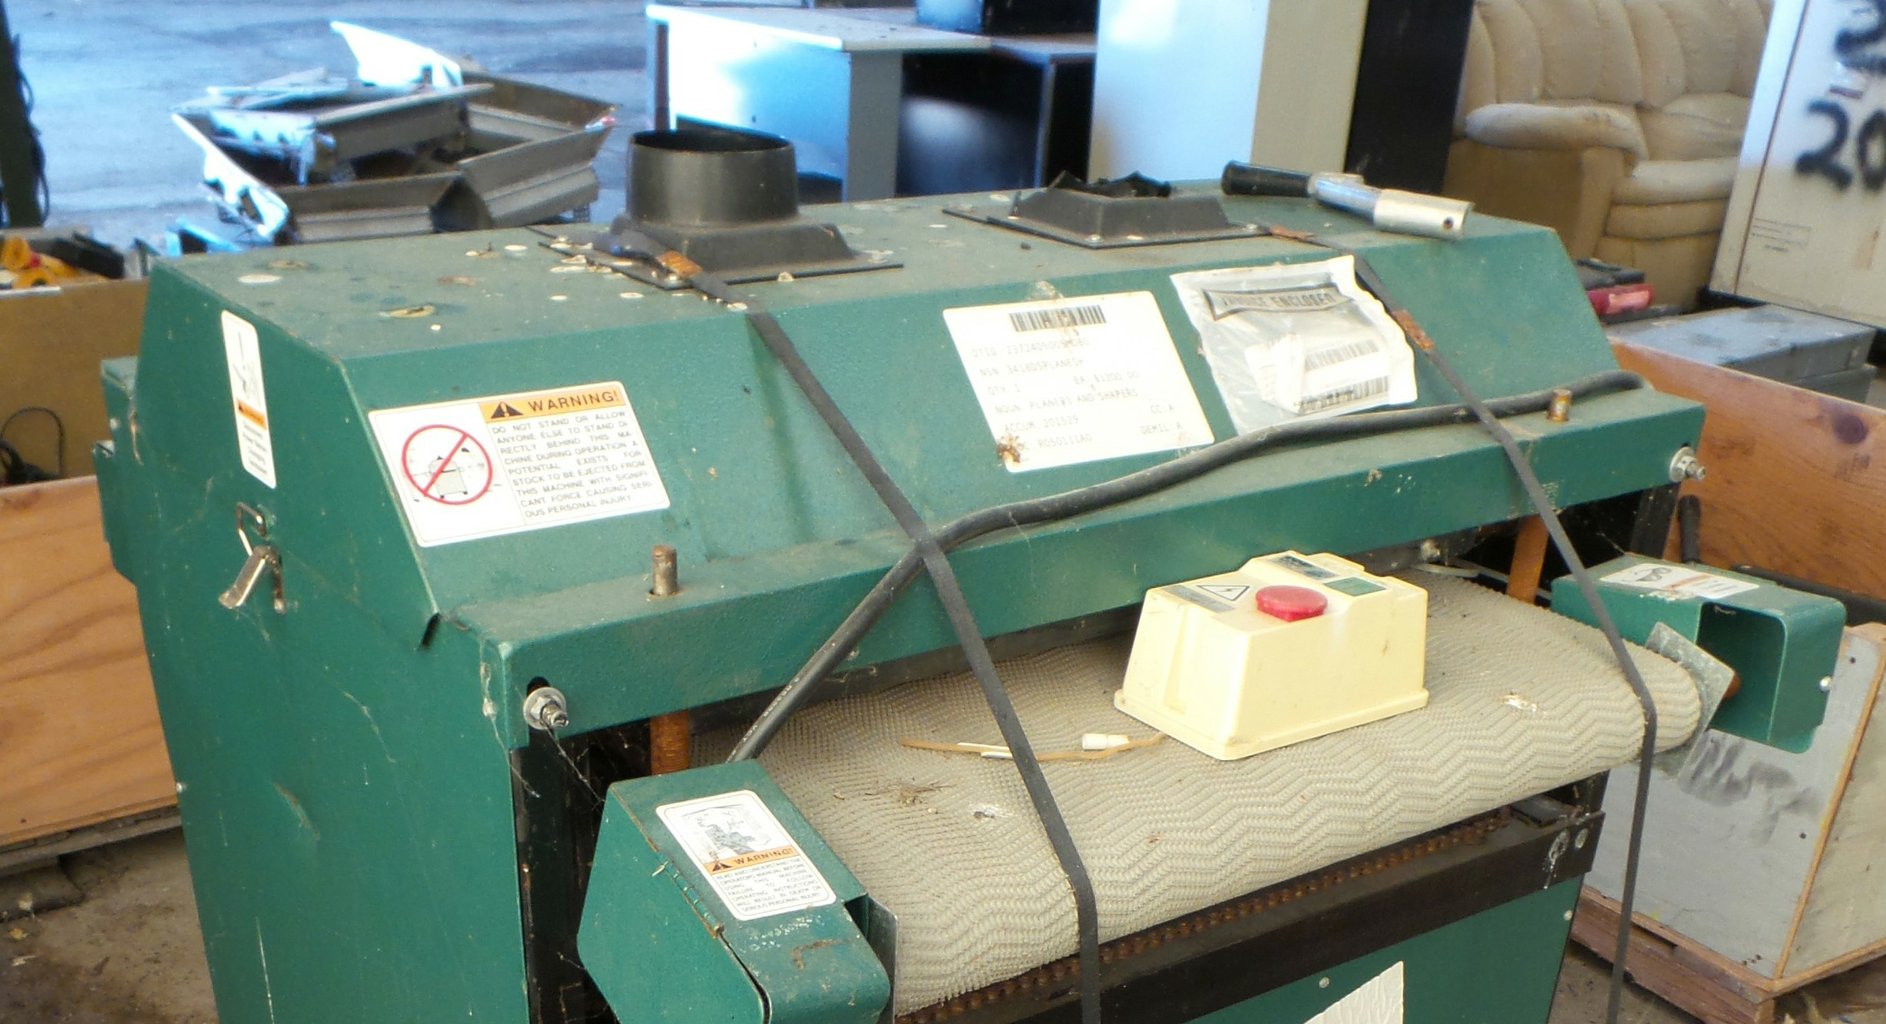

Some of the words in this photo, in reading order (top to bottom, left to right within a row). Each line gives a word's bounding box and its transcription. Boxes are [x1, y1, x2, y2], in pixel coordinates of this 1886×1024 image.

[528, 390, 619, 412] WARNING!
[491, 426, 506, 434] DO
[512, 423, 532, 432] NOT
[538, 418, 570, 428] STAND
[595, 410, 625, 420] ALLOW
[497, 433, 537, 444] ANYONE
[540, 429, 563, 439] ELSE
[568, 427, 580, 435] TO
[584, 422, 615, 432] STAND
[500, 444, 537, 455] RECTLY
[546, 437, 581, 449] BEHIND
[590, 434, 609, 442] THIS
[504, 455, 533, 465] CHINE
[536, 449, 572, 461] DURING
[508, 462, 561, 475] POTENTIAL
[576, 455, 608, 466] EXISTS
[624, 450, 642, 459] FOR
[512, 475, 545, 486] STOCK
[548, 472, 561, 480] TO
[562, 471, 575, 479] BE
[578, 464, 618, 476] EJECTED
[620, 460, 645, 470] FROM
[516, 487, 538, 497] THIS
[543, 480, 584, 493] MACHINE
[589, 476, 611, 485] WITH
[734, 848, 792, 865] WARNING!
